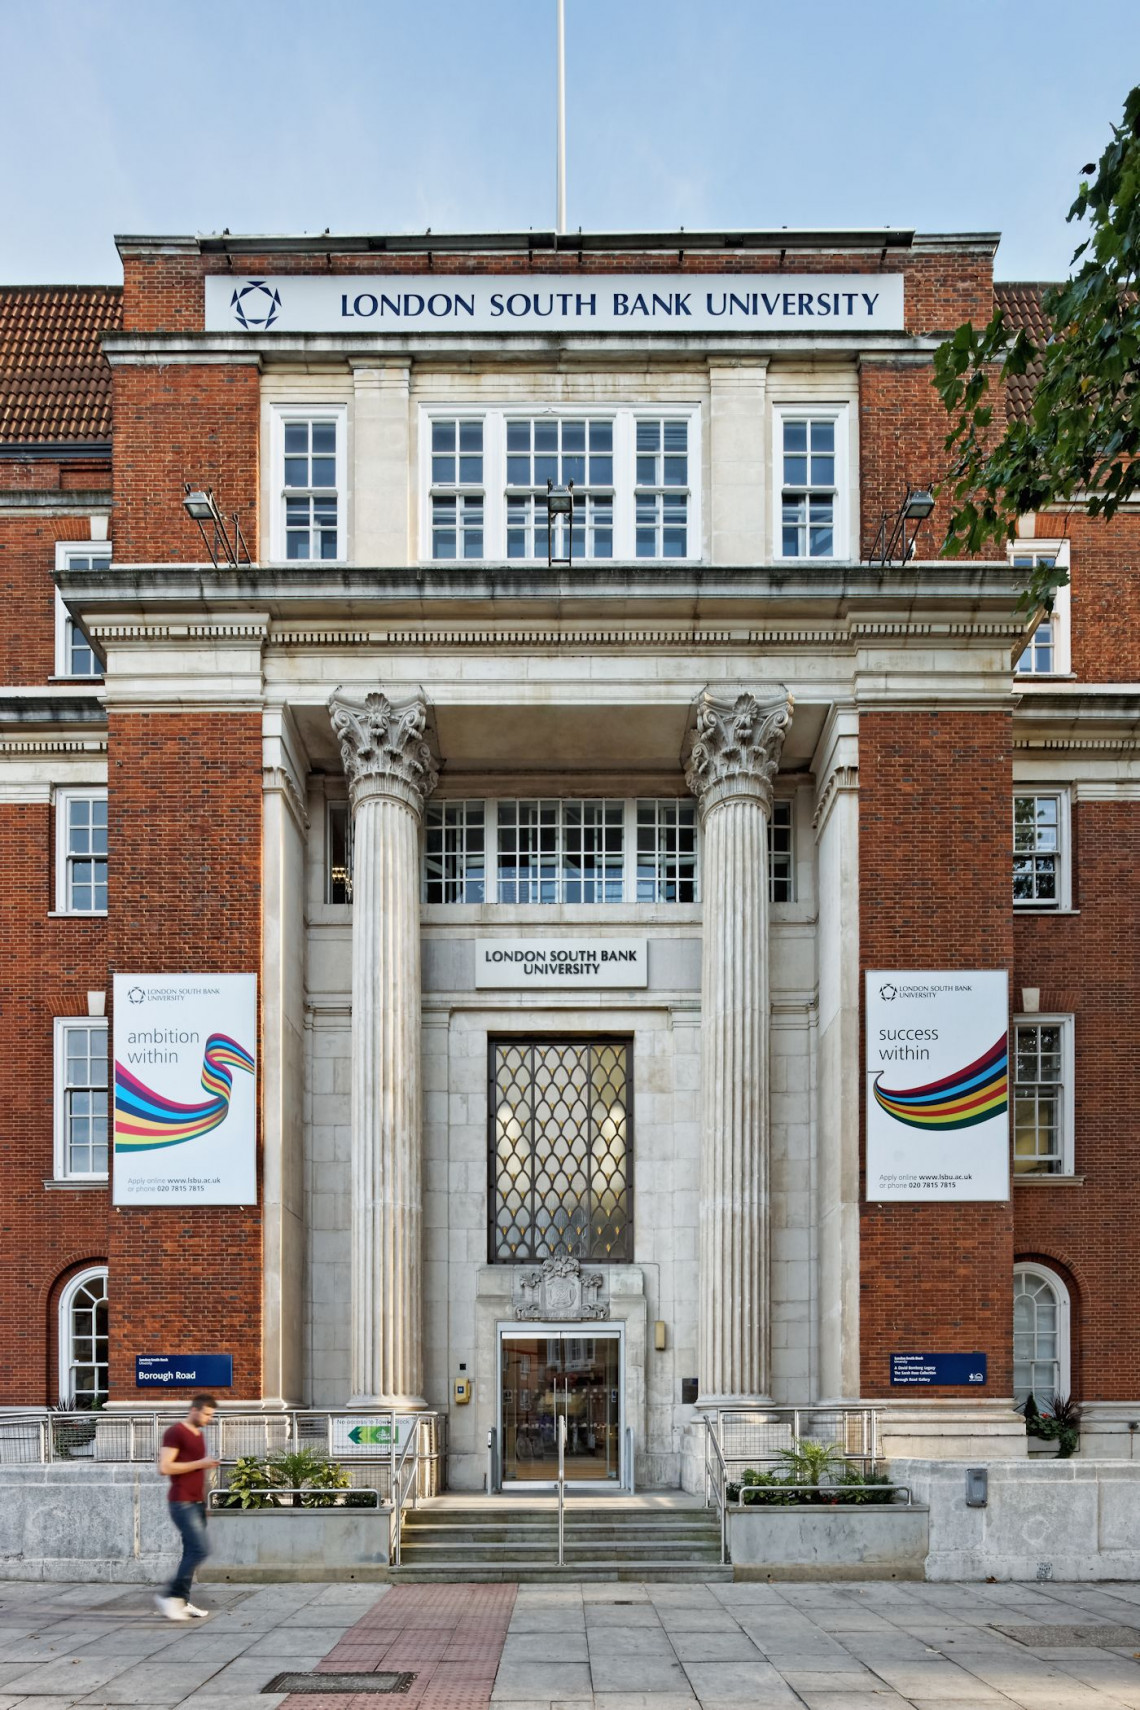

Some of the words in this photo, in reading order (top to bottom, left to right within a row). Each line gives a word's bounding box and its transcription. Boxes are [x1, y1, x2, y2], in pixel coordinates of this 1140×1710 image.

[341, 293, 475, 317] LONDON
[490, 293, 597, 317] SOUTH
[613, 293, 693, 316] BANK
[706, 293, 880, 316] UNIVERSITY
[485, 950, 546, 962] LONDON
[550, 950, 597, 962] SOUTH
[601, 950, 637, 961] BANK
[523, 963, 601, 975] UNIVERSITY
[127, 1028, 200, 1044] ambition
[879, 1029, 939, 1041] success
[127, 1048, 178, 1064] within
[879, 1044, 930, 1060] within
[128, 1177, 145, 1185] Apply
[167, 1176, 221, 1184] www.lsbu.ac.uk
[879, 1174, 897, 1182] Apply
[135, 1185, 155, 1193] phone
[887, 1182, 907, 1190] phone
[138, 1371, 174, 1382] Borough
[175, 1371, 196, 1379] Road
